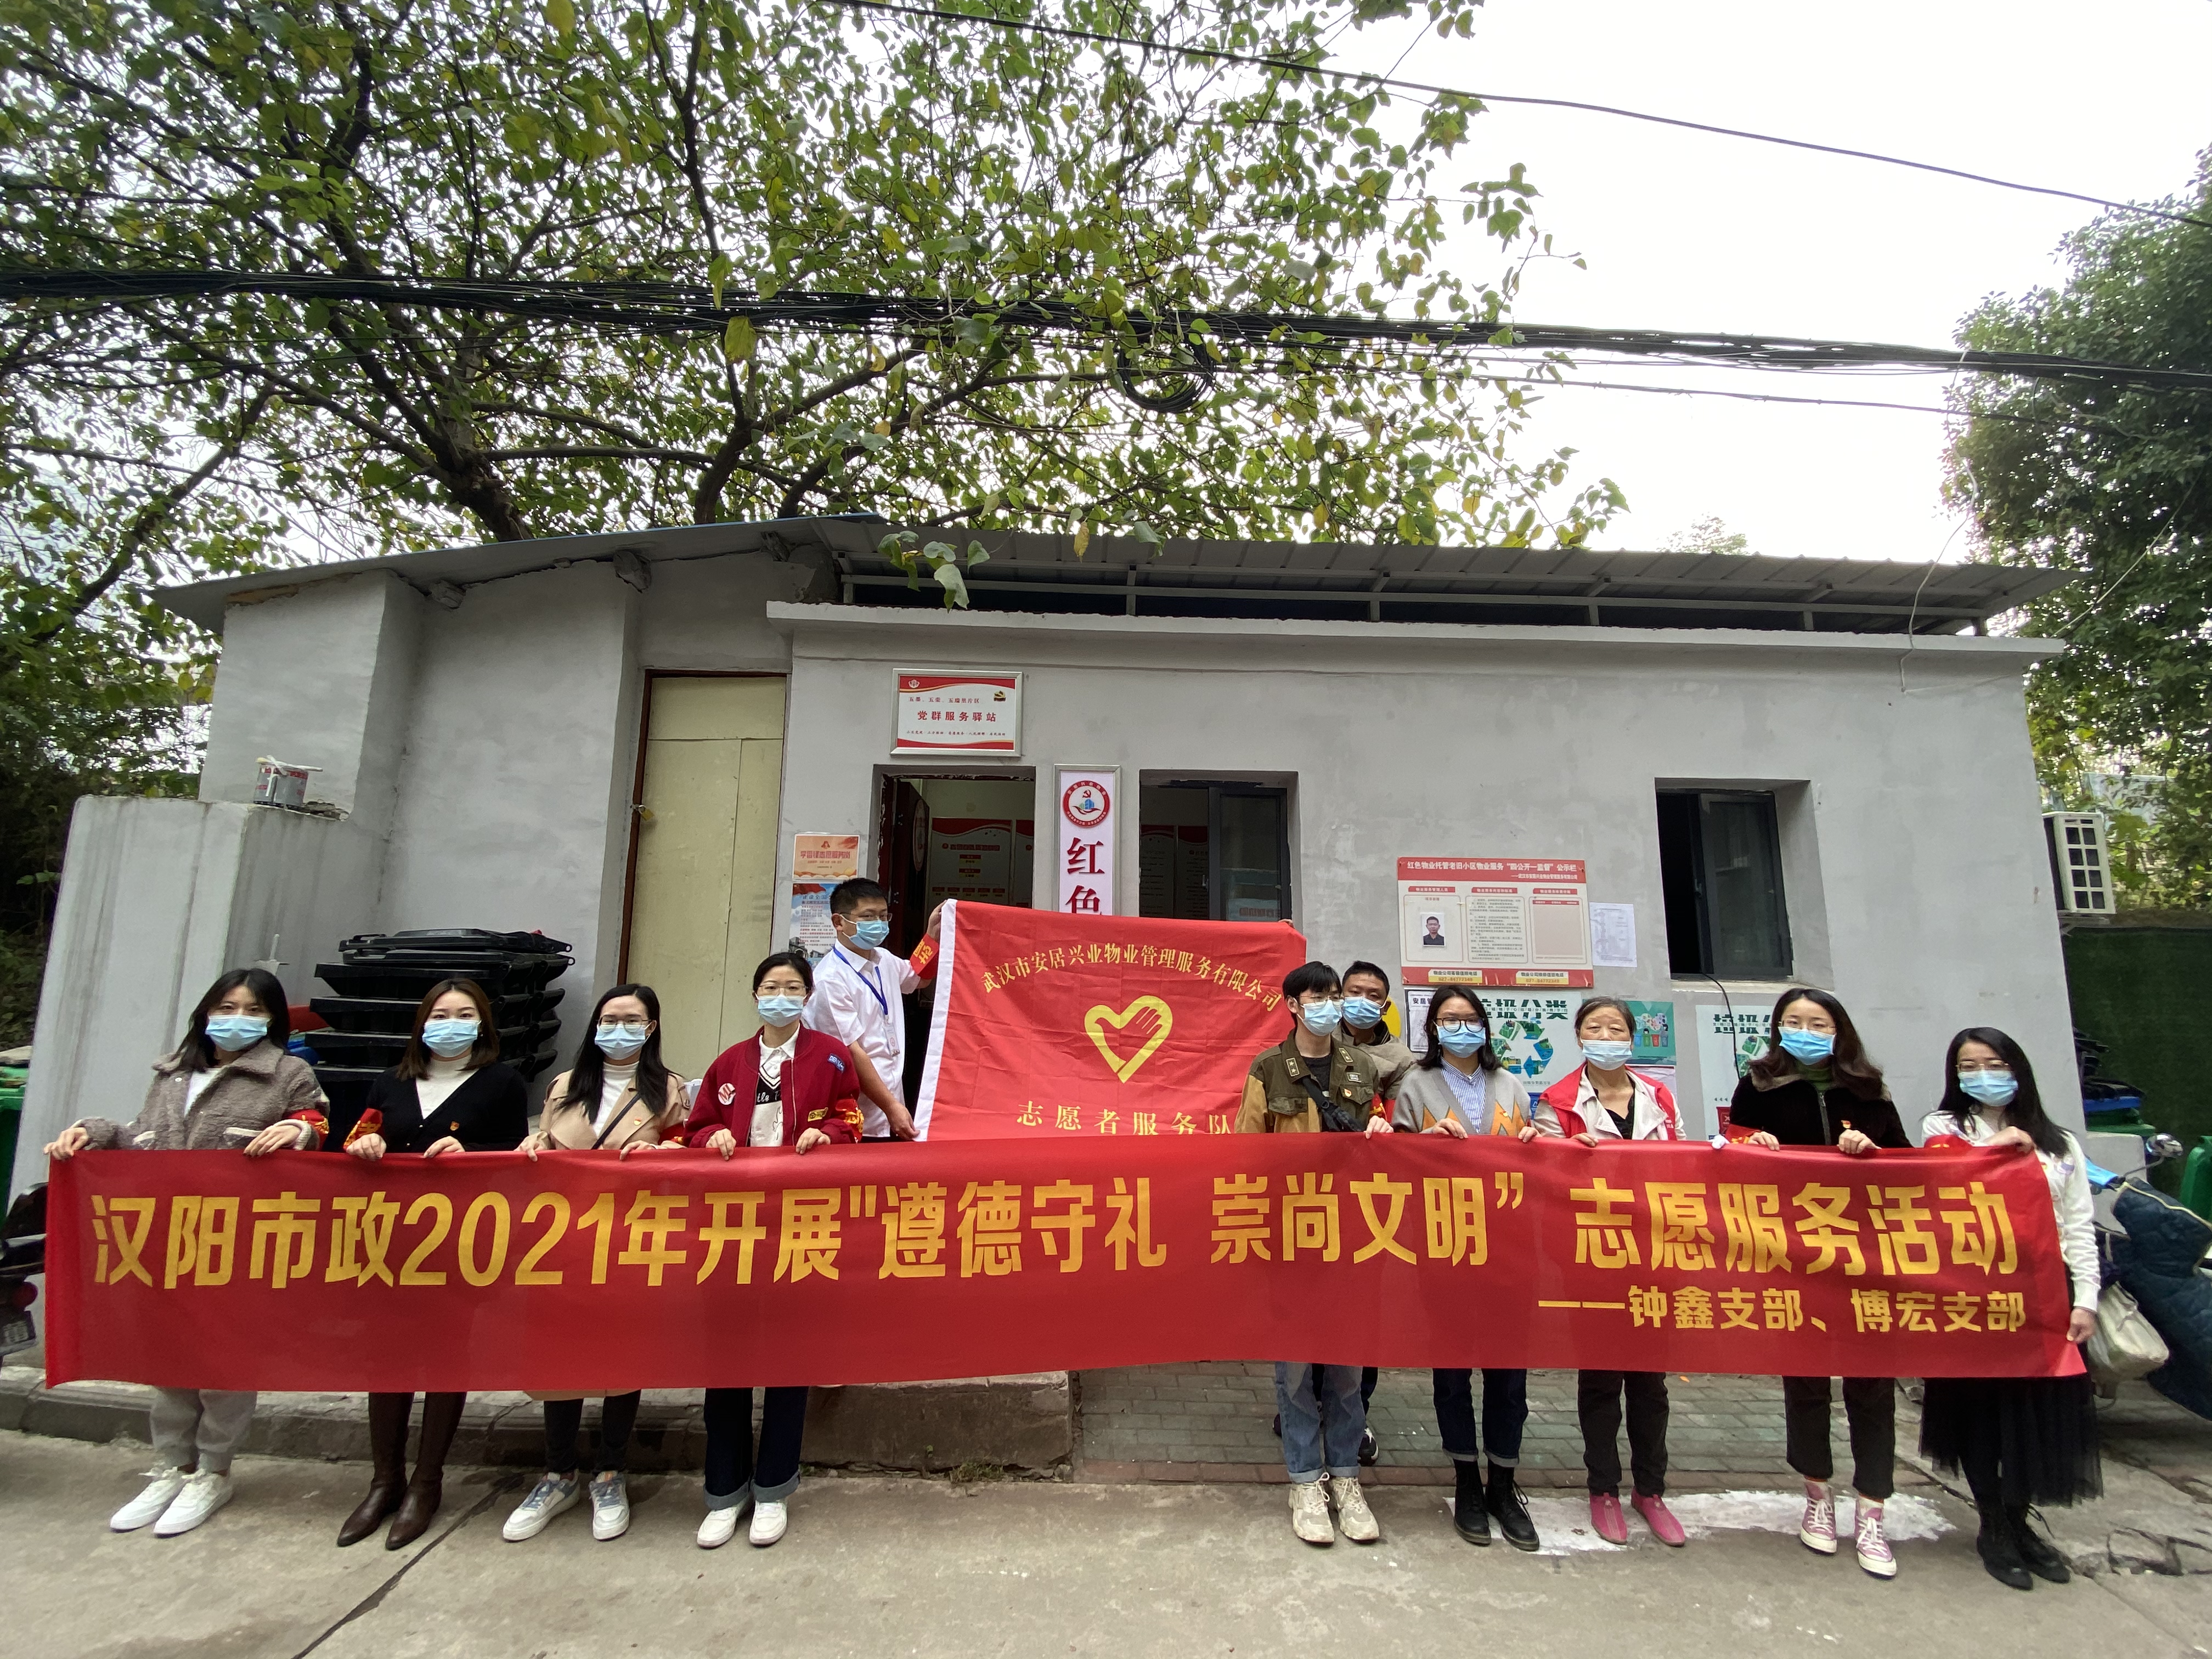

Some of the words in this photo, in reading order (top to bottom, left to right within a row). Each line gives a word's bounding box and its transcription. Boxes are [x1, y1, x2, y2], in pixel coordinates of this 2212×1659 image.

[917, 710, 996, 722] 党群服务驿站
[980, 943, 1282, 1011] 武汉市安居兴业物业管理服务有限公司
[1017, 1101, 1232, 1135] 志愿者服务队
[1569, 1177, 2018, 1276] 志愿服务活动
